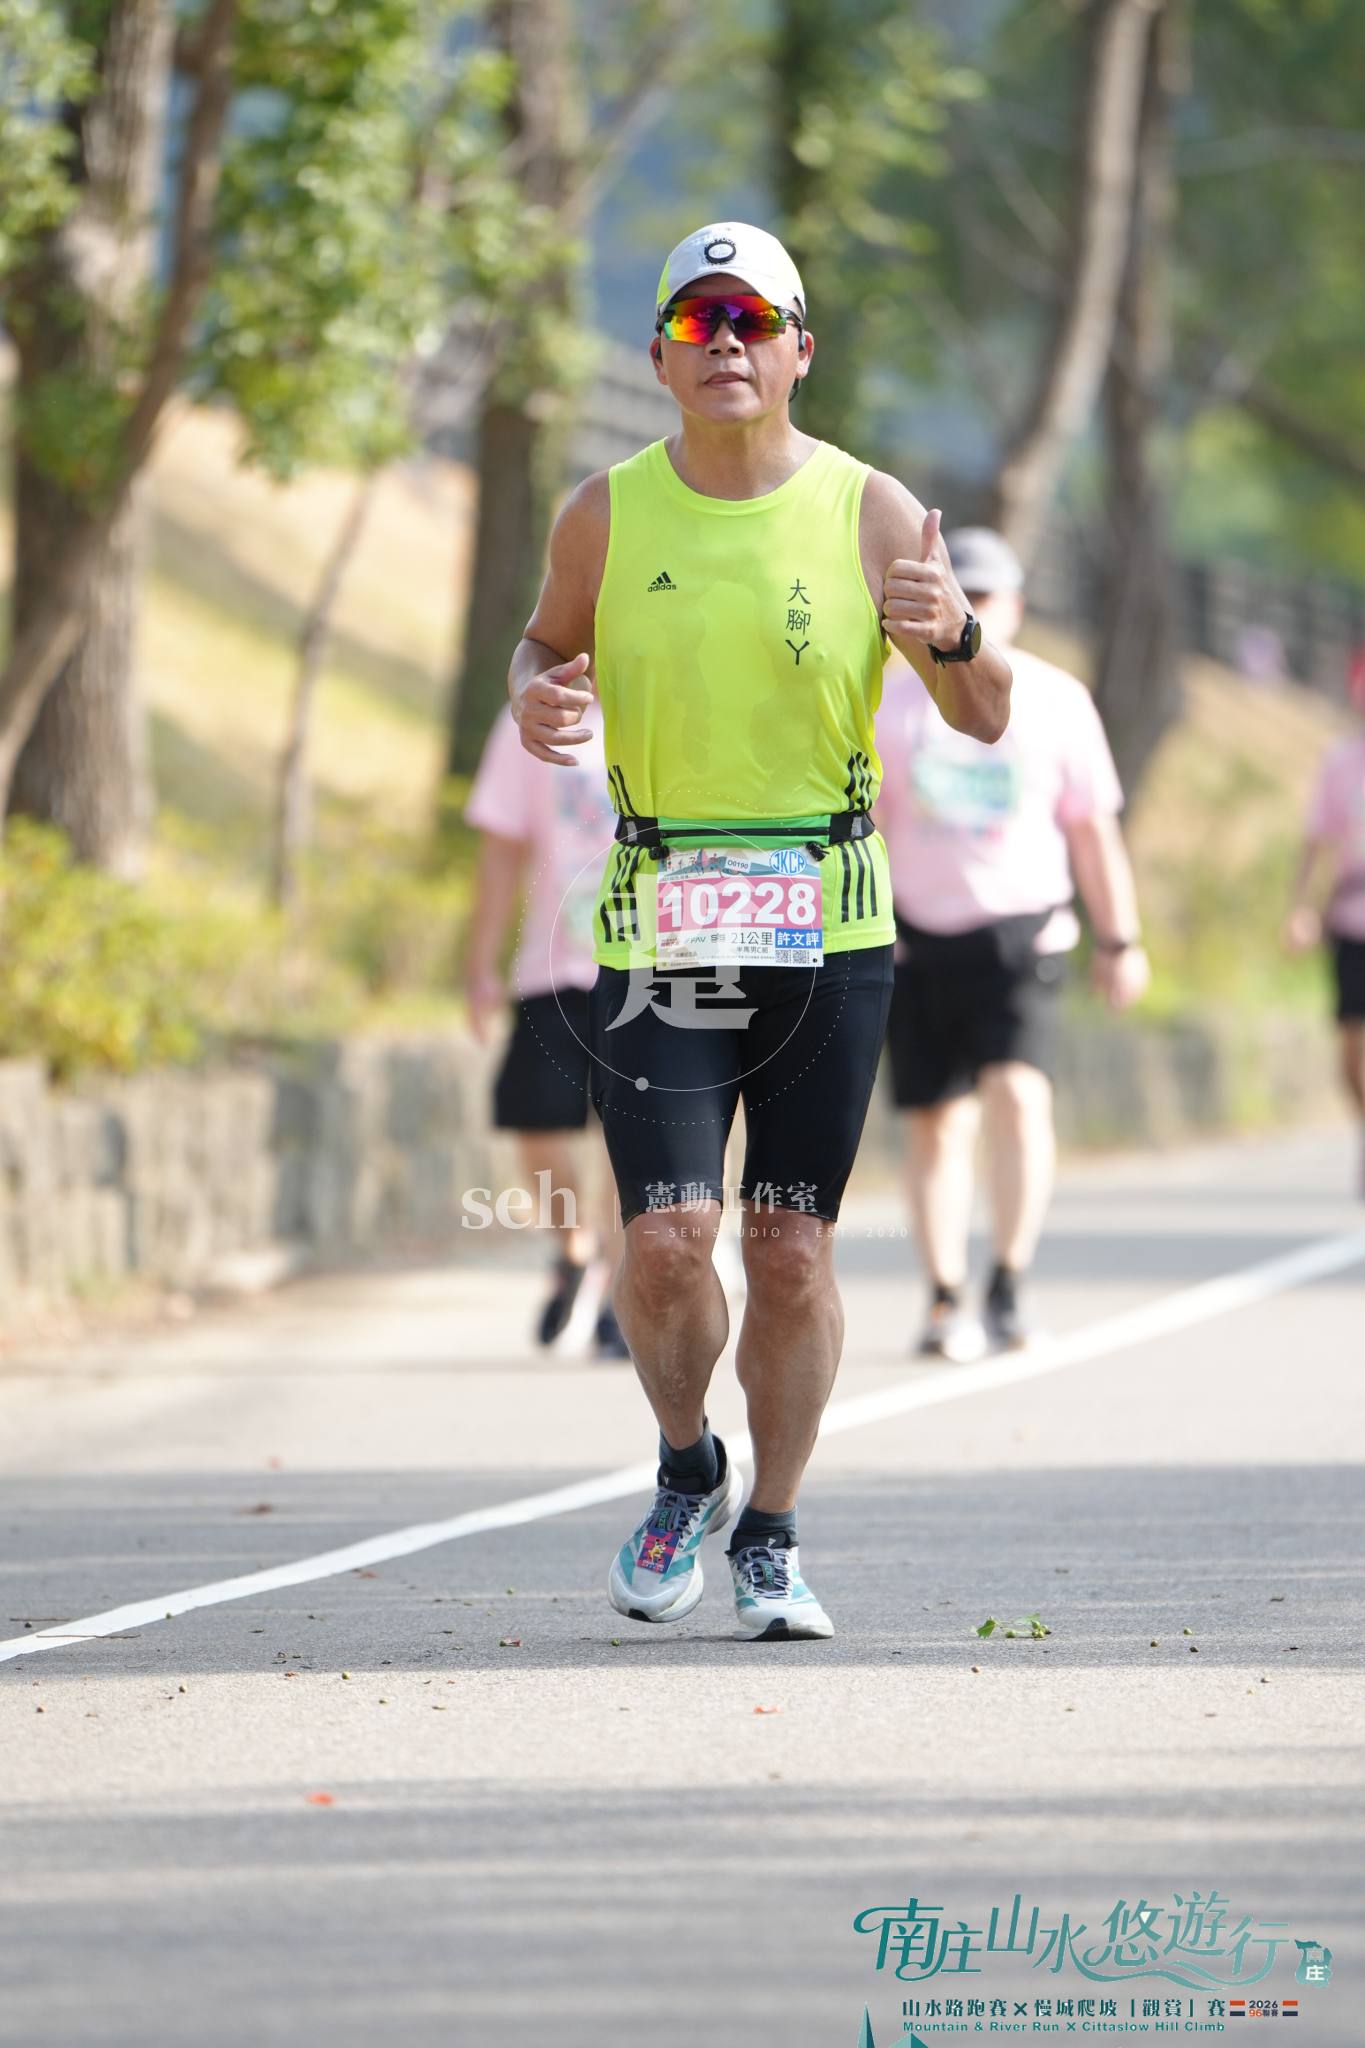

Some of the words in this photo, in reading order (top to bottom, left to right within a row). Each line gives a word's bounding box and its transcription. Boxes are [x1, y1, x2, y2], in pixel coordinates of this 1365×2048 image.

[647, 582, 677, 593] adidas
[772, 850, 806, 875] JKCR
[662, 881, 816, 928] 10228
[731, 931, 773, 946] 21公里
[777, 932, 820, 947] 許文評
